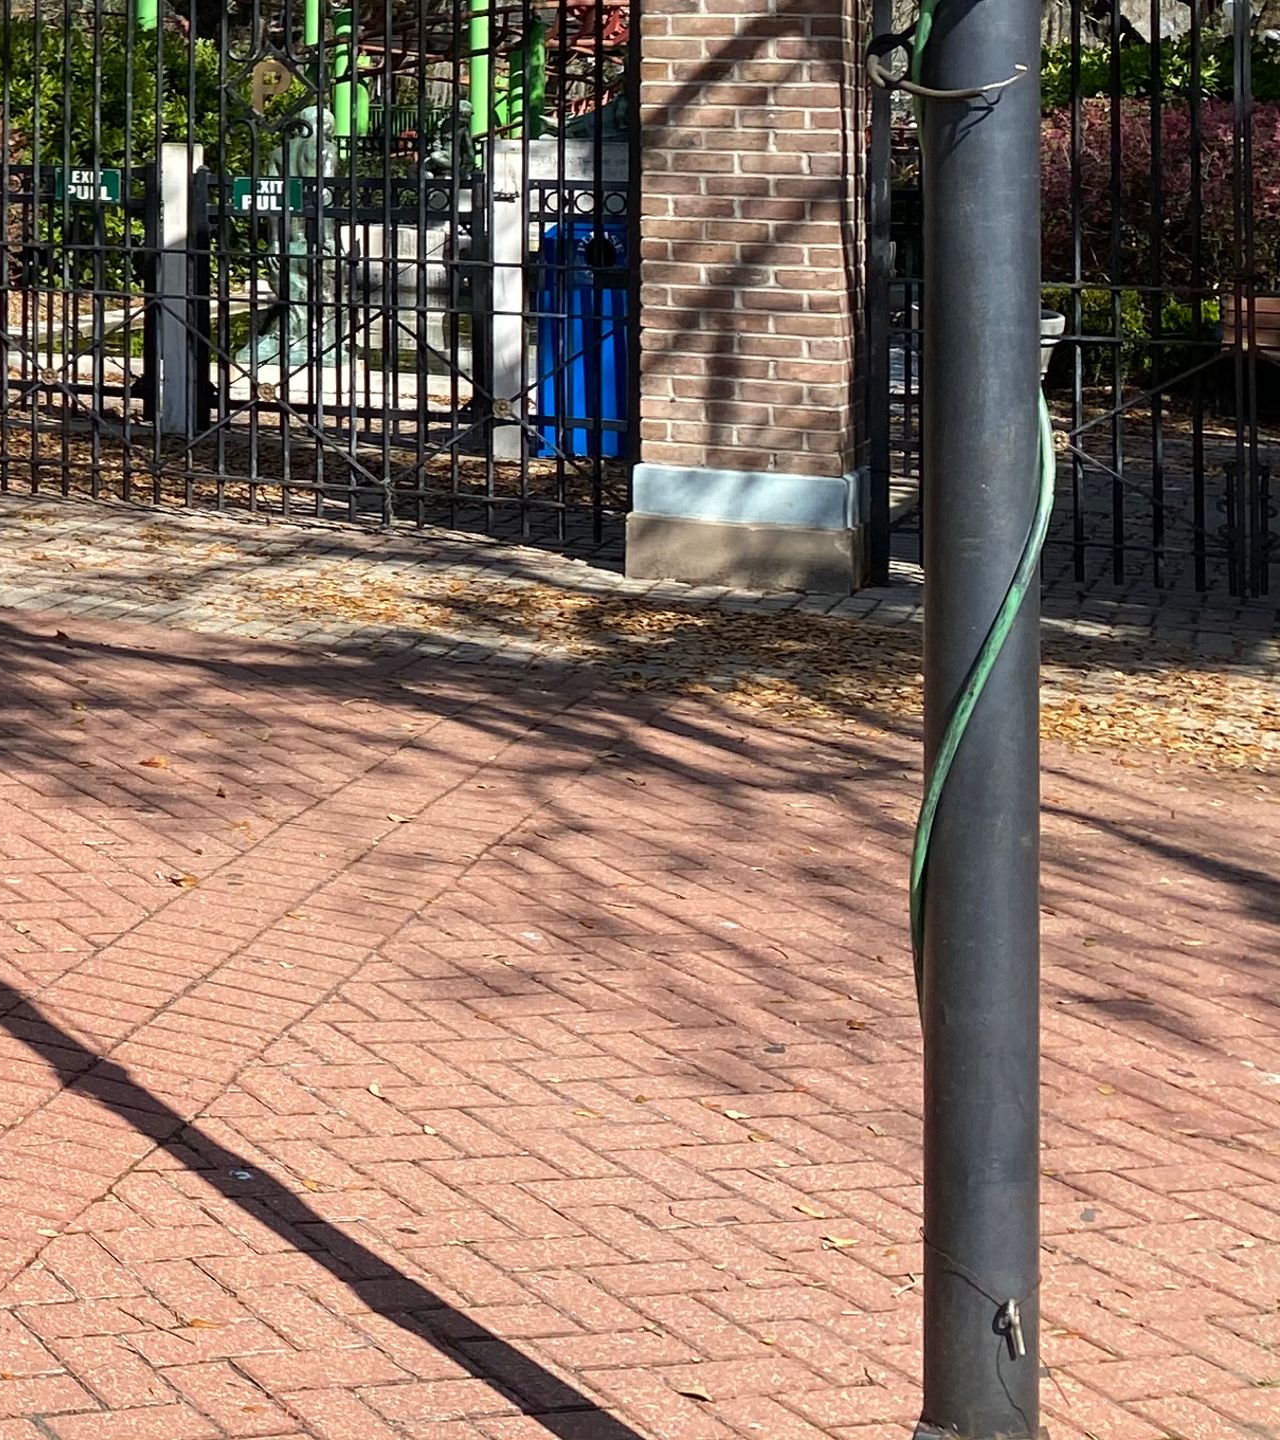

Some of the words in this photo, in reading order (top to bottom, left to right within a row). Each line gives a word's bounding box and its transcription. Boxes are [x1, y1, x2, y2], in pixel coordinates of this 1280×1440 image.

[250, 58, 291, 117] P
[71, 170, 104, 184] EXIT
[67, 184, 113, 201] PULL
[241, 194, 295, 211] PUL
[576, 230, 625, 254] PLSE
